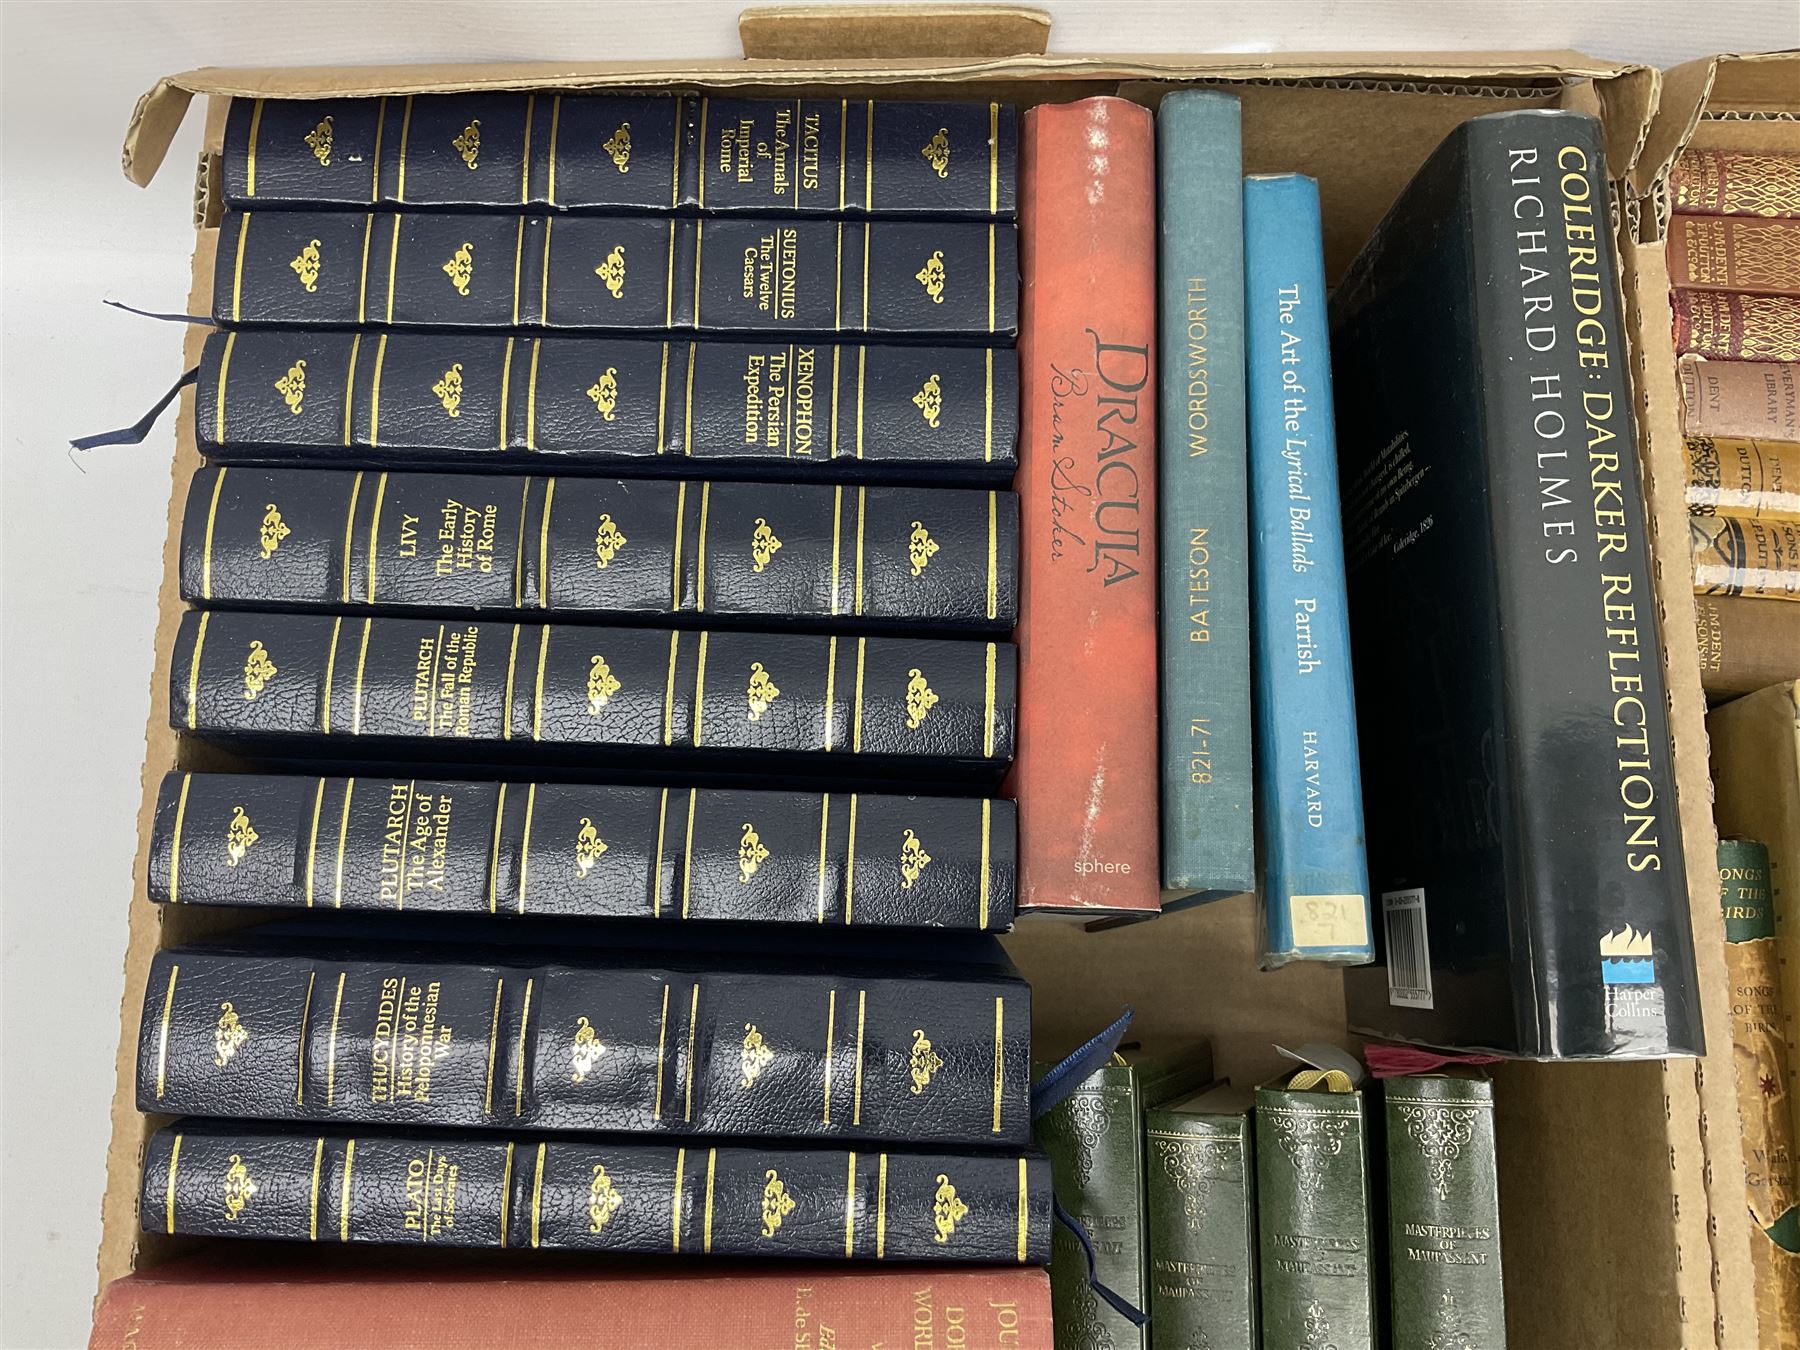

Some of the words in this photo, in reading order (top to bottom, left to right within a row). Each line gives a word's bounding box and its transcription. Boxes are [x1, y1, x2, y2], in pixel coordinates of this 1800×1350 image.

[775, 109, 791, 137] The
[720, 129, 736, 172] Rome
[735, 119, 754, 182] Imperial
[757, 141, 771, 159] of
[774, 139, 790, 195] Annals
[803, 114, 820, 189] TACITUS
[760, 235, 774, 261] The
[1508, 147, 1557, 352] RICHARD
[1557, 145, 1609, 380] COLERIDGE:
[743, 248, 758, 298] Caesars
[759, 264, 773, 311] Twelve
[782, 229, 797, 319] SUETONIUS
[1278, 283, 1299, 324] The
[769, 352, 786, 382] The
[1188, 277, 1208, 458] WORDSWORTH
[1281, 330, 1301, 365] Art
[743, 355, 765, 443] Expedition
[795, 348, 815, 455] XENOPHON
[1282, 370, 1305, 393] of
[1707, 376, 1721, 413] DENT
[1764, 373, 1778, 424] LIBRARY
[767, 386, 785, 447] Persian
[1050, 363, 1089, 453] Bram
[1284, 396, 1307, 432] the
[1085, 327, 1148, 588] DRACULA
[1281, 438, 1312, 502] Lyrical
[1530, 374, 1577, 565] HOLMES
[1582, 391, 1628, 561] DARKER
[439, 499, 463, 540] Early
[477, 504, 497, 552] Rome
[1050, 456, 1092, 562] Stoker
[400, 514, 420, 558] LIVY
[457, 507, 481, 568] History
[1290, 507, 1314, 574] Ballads
[437, 543, 454, 576] The
[475, 556, 492, 573] of
[1190, 527, 1210, 643] BATESON
[451, 632, 461, 652] the
[459, 626, 479, 683] Republic
[1295, 598, 1322, 674] Parrish
[413, 638, 435, 721] PLUTARCH
[443, 655, 458, 669] of
[440, 671, 455, 700] Fall
[439, 703, 454, 730] The
[455, 687, 470, 737] Roman
[1600, 573, 1661, 873] REFLECTIONS
[1191, 718, 1213, 784] 821-71
[1303, 731, 1322, 828] HARVARD
[416, 793, 433, 813] of
[381, 784, 409, 900] PLUTARCH
[410, 816, 432, 852] Age
[427, 795, 453, 891] Alexander
[407, 855, 425, 891] The
[1074, 859, 1132, 876] sphere
[1720, 868, 1763, 881] ONGS
[1306, 901, 1346, 920] 821
[1721, 906, 1764, 919] IRDS
[1738, 887, 1767, 900] THE
[410, 986, 422, 1005] the
[1604, 985, 1656, 1004] Harper
[1605, 1002, 1657, 1018] Collins
[1733, 1004, 1752, 1015] OF
[402, 1007, 418, 1028] of
[372, 977, 398, 1103] THUCYDIDES
[415, 981, 441, 1103] Peloponnesian
[434, 1025, 453, 1059] War
[397, 1029, 419, 1096] History
[433, 1155, 447, 1183] Days
[404, 1159, 424, 1230] PLATO
[430, 1213, 442, 1236] The
[444, 1212, 454, 1229] of
[1407, 1247, 1487, 1265] MAUPASSANT
[1440, 1240, 1457, 1250] OF
